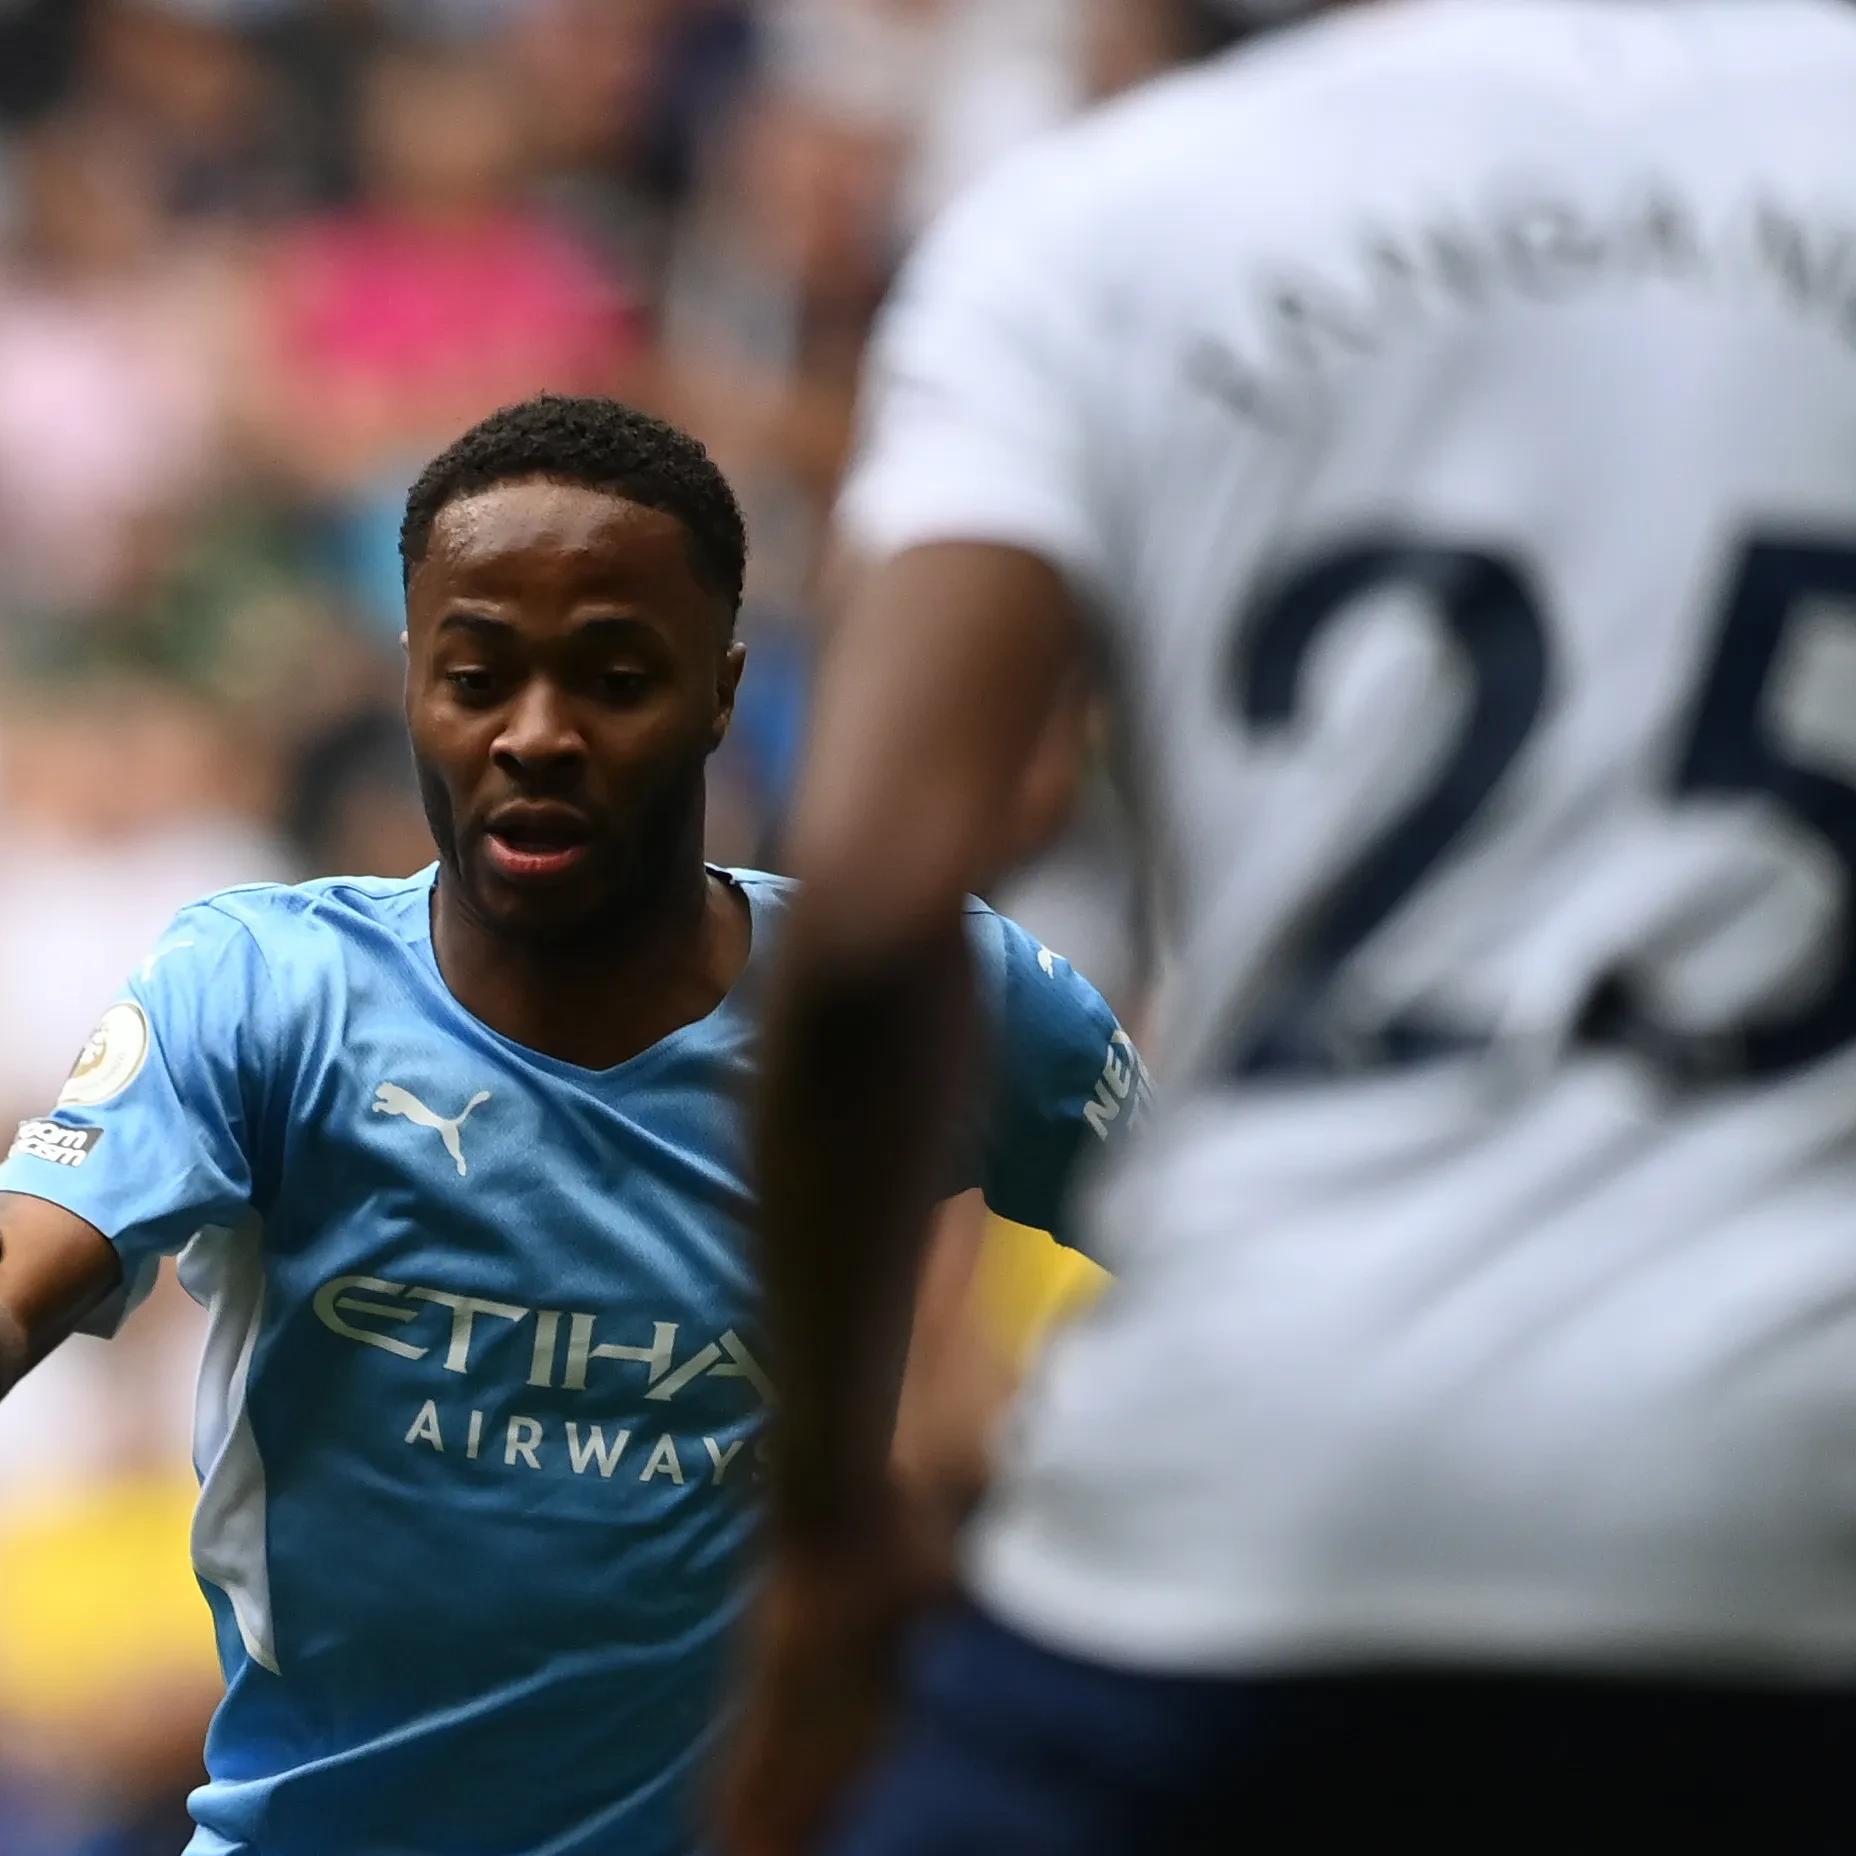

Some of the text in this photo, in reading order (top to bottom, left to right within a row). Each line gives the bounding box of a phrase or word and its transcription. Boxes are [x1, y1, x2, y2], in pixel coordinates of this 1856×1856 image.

[1221, 535, 1856, 1092] 25
[313, 1275, 776, 1402] ETIHA
[404, 1399, 770, 1487] AIRWAY
